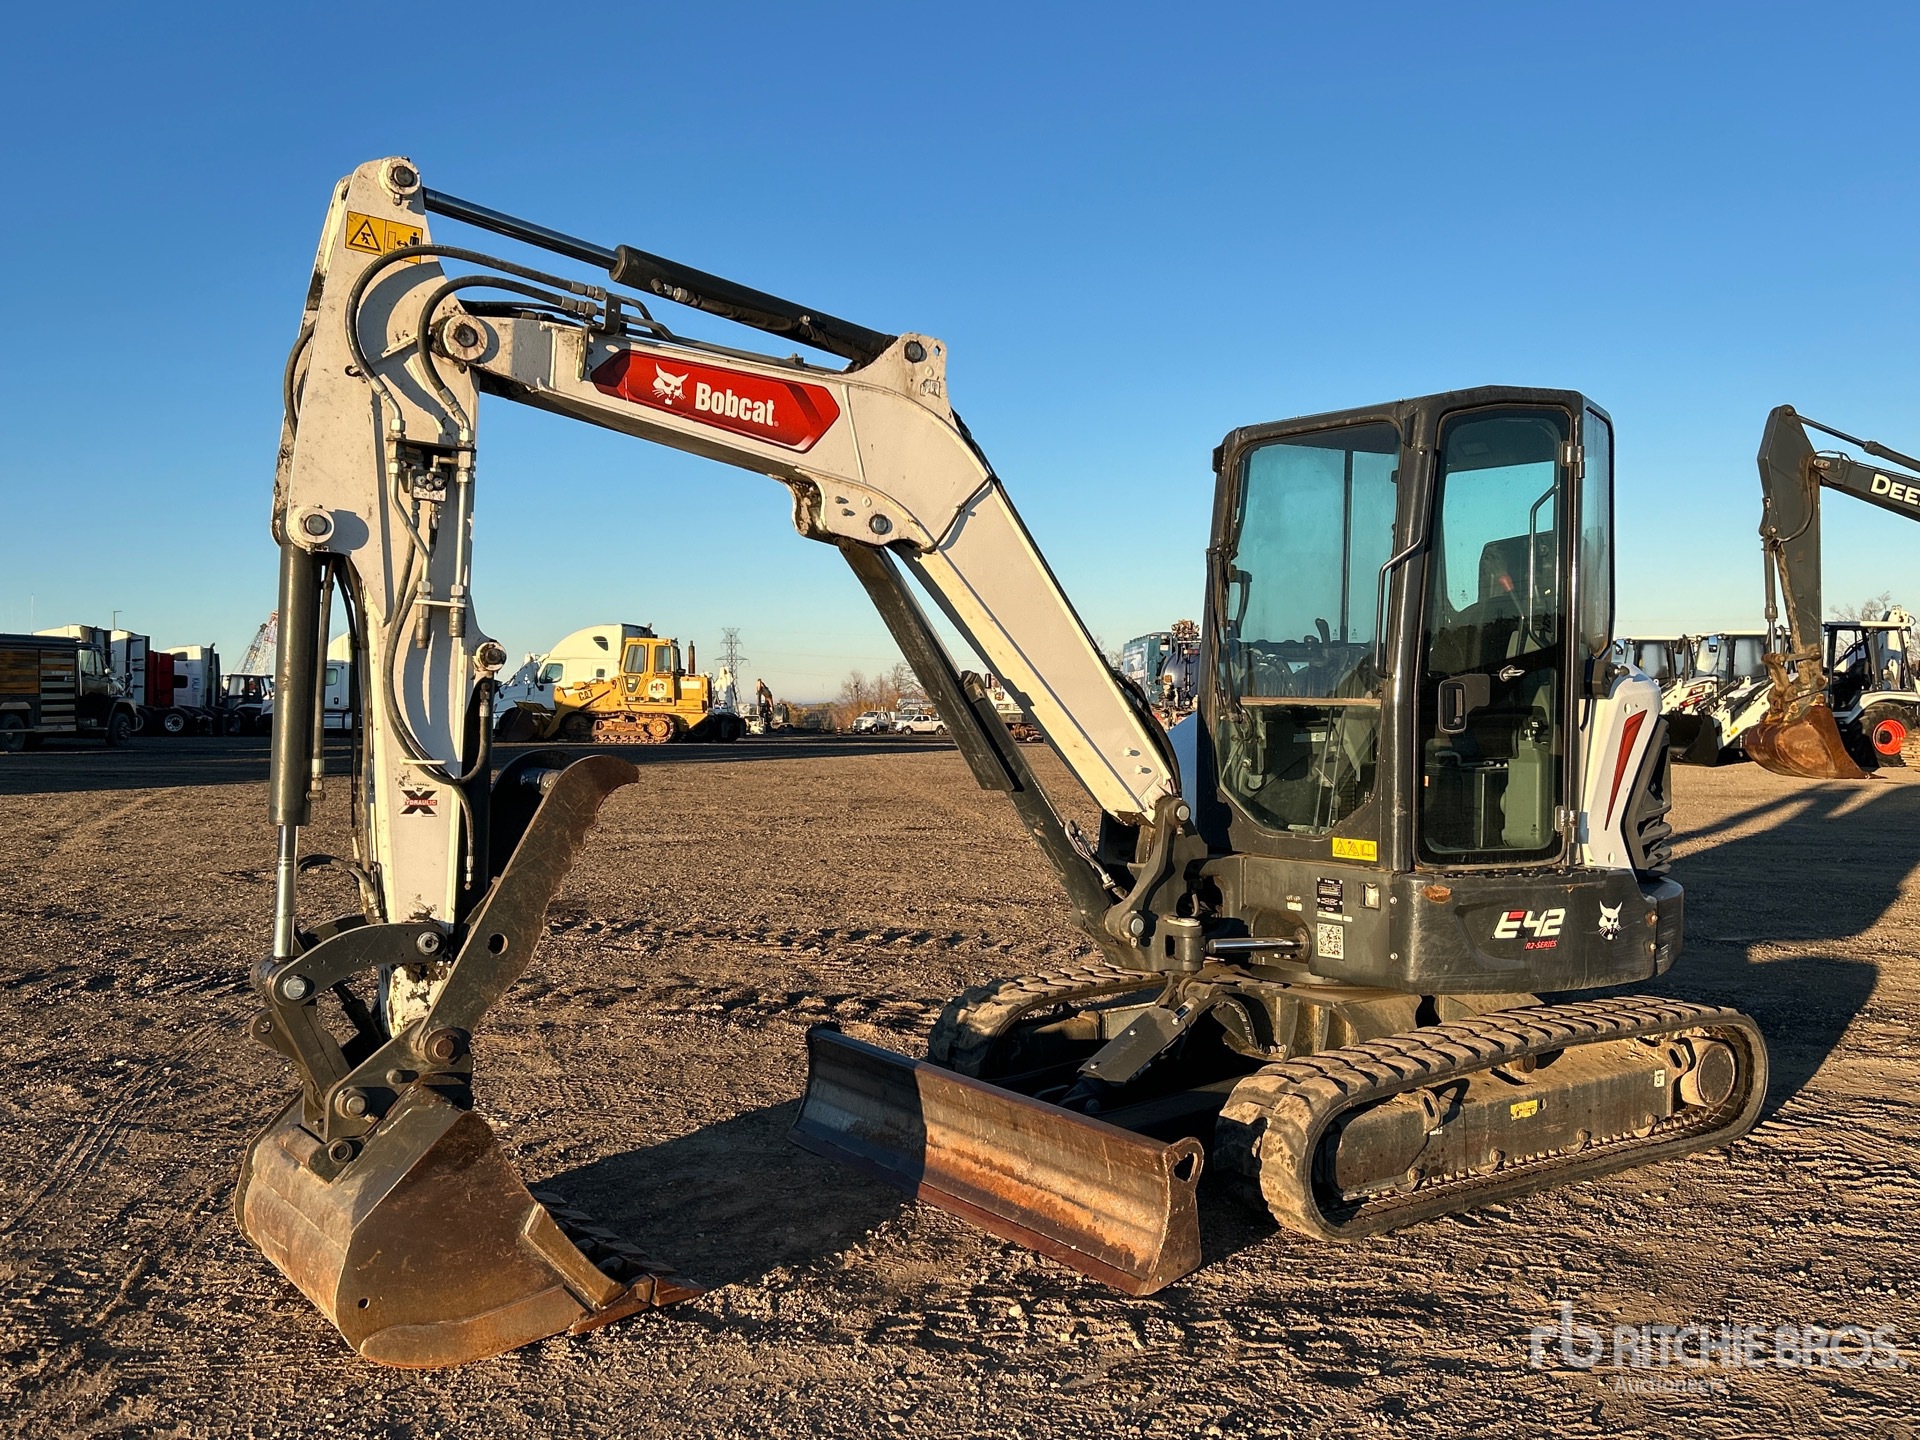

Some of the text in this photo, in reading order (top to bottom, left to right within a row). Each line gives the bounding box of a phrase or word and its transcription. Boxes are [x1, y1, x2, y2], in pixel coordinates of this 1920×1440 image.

[694, 381, 775, 427] Bobcat
[1870, 473, 1920, 507] DEE
[578, 689, 593, 701] CAT
[1493, 907, 1566, 939] E42
[1525, 940, 1558, 950] R2-SERIES
